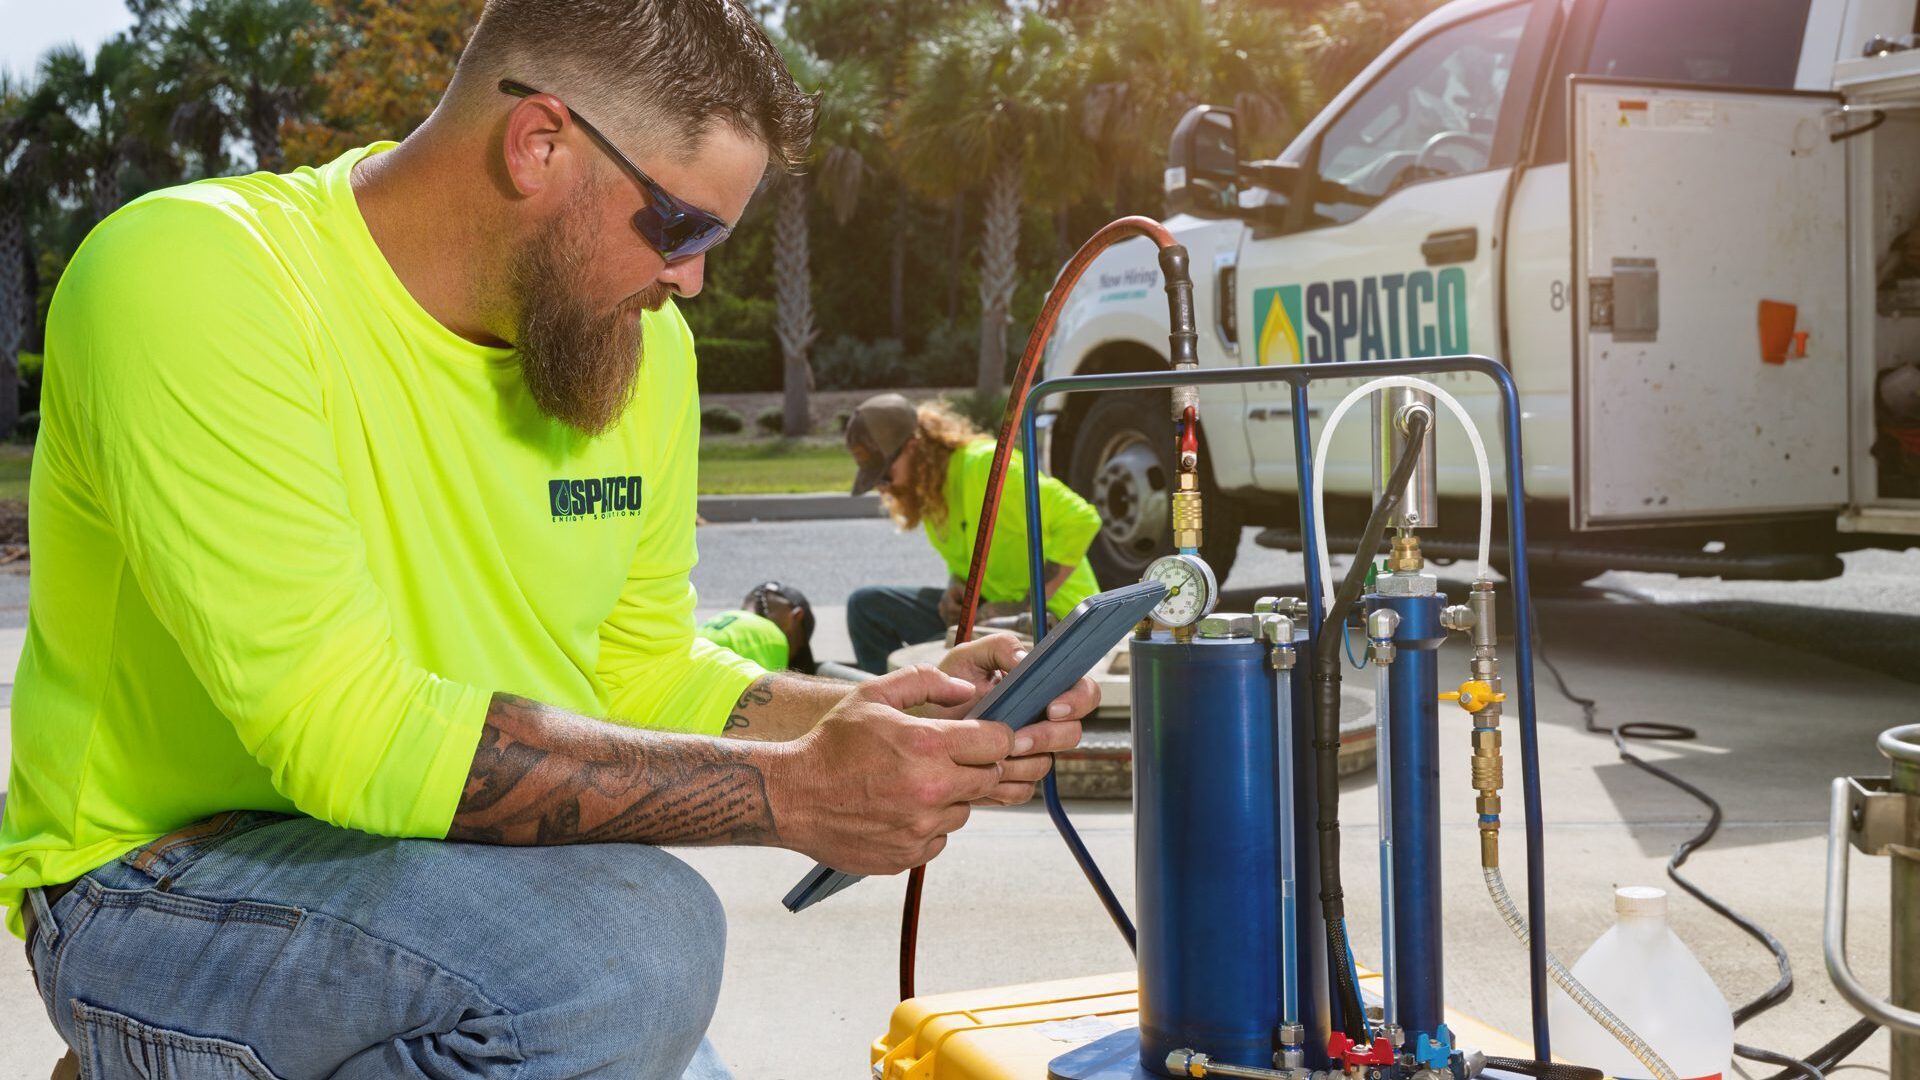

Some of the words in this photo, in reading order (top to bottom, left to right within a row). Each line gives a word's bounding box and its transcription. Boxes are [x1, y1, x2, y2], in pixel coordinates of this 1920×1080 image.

[1100, 274, 1121, 288] Now
[1123, 268, 1158, 288] Hiring
[1306, 267, 1469, 364] SPATCO
[570, 476, 642, 515] SPATCO
